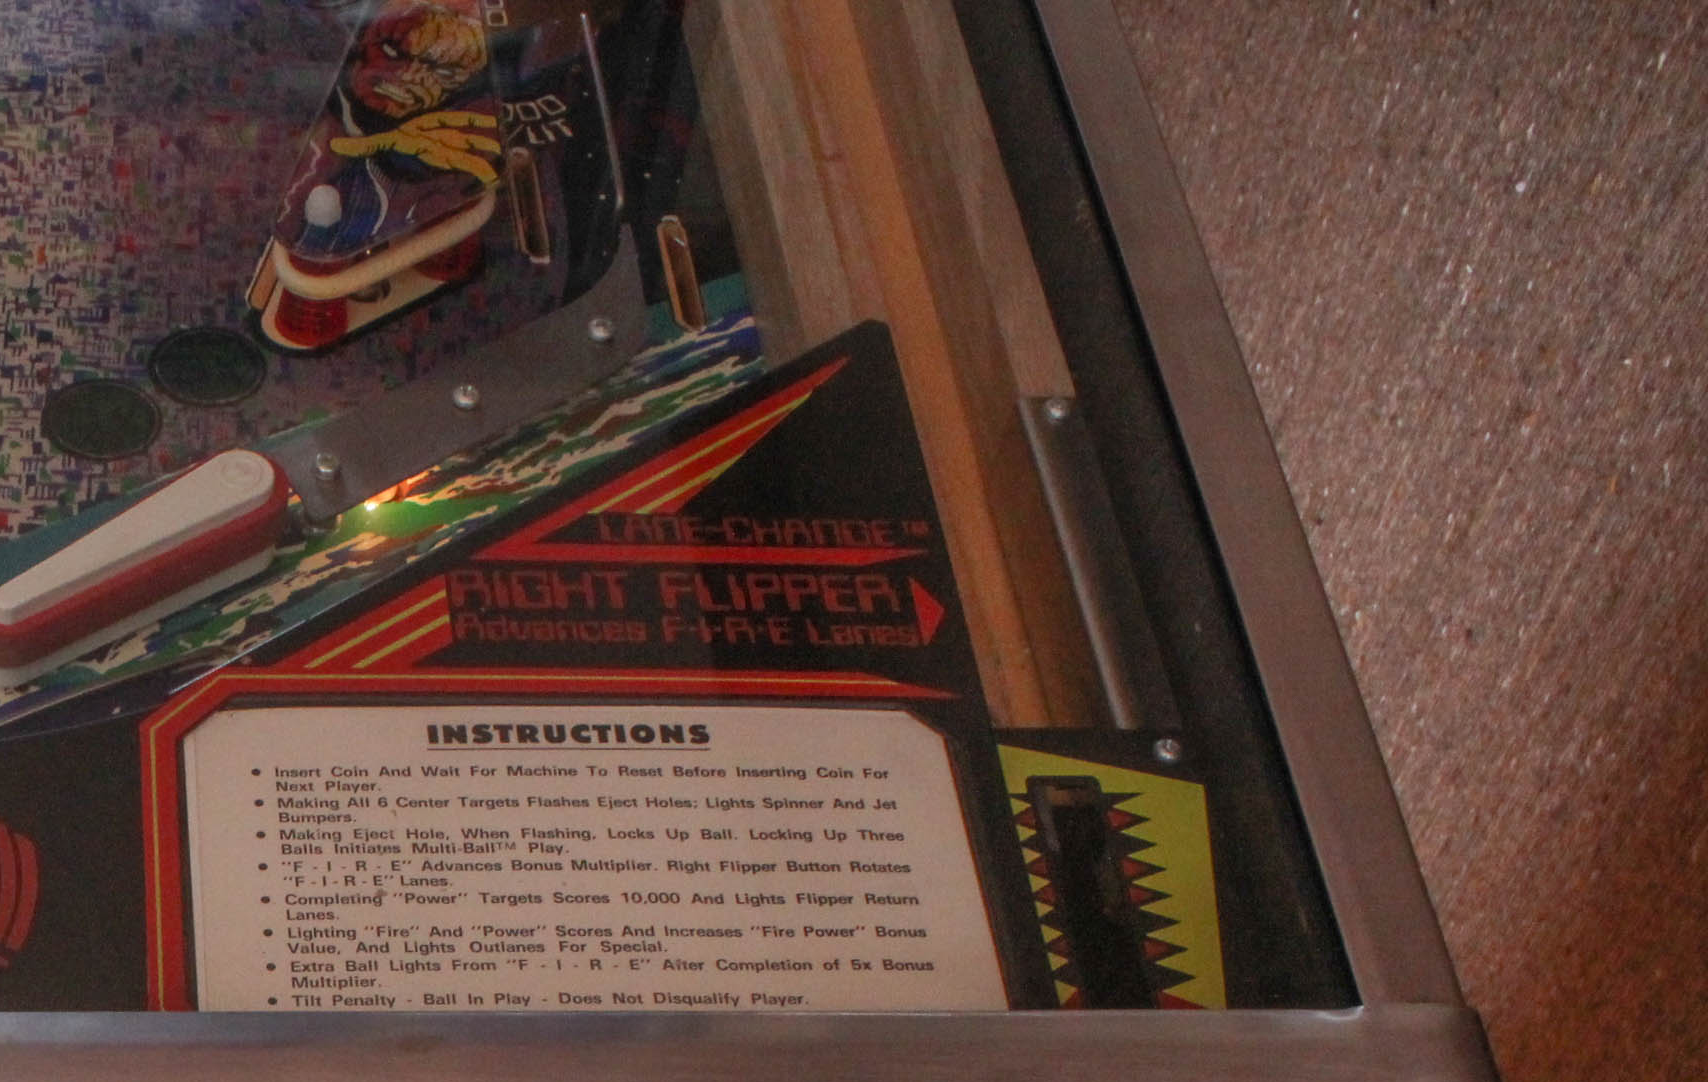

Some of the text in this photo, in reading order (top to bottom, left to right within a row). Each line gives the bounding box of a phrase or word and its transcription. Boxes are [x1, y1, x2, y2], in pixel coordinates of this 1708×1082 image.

[448, 570, 901, 613] RIGHT FLIPPER
[453, 612, 648, 643] Advances
[807, 619, 922, 648] Lanes
[426, 723, 711, 745] INSTRUCTIONS
[274, 764, 889, 782] Insert Coin And Wait For Machine To Reset Before Inserting Coin For
[275, 779, 382, 795] Next Player.
[276, 796, 340, 812] Making
[347, 796, 370, 809] All
[377, 795, 389, 809] 6
[395, 795, 450, 809] Center
[456, 795, 521, 811] Targets
[526, 794, 591, 809] Flashes
[596, 795, 639, 811] Eject
[705, 796, 756, 812] Lights
[761, 795, 825, 812] Spinner
[832, 796, 866, 811] And
[872, 797, 898, 812] Jet
[278, 810, 357, 825] Bumpers.
[278, 827, 905, 844] Making Eject Hole, When Flashing, Locks Up Ball. Locking Up Three
[280, 842, 324, 856] Balls
[333, 842, 401, 854] Initiates
[527, 841, 570, 857] Play.
[421, 858, 912, 876] Advances Bonus Multiplier. Right Flipper Button Rotates
[399, 874, 453, 890] Lanes.
[284, 892, 384, 907] Completing
[477, 891, 543, 908] Targets
[552, 890, 611, 905] Scores
[620, 890, 681, 905] 10,000
[691, 891, 725, 905] And
[734, 891, 787, 908] Lights
[795, 891, 854, 908] Flipper
[863, 892, 920, 907] Return
[285, 908, 340, 922] Lanes.
[287, 925, 357, 943] Lighting
[428, 924, 464, 939] And
[554, 924, 613, 938] Scores
[621, 925, 656, 938] And
[663, 924, 744, 939] Increases
[874, 925, 928, 939] Bonus
[286, 939, 668, 957] Value, And Lights Outlanes For Special.
[289, 957, 935, 976] Extra Ball Lights From After Completion of 5x Bonus
[291, 975, 382, 990] Multiplier.
[291, 991, 810, 1008] Tilt Penalty Ball In Play Does Not Disqualify Player.
